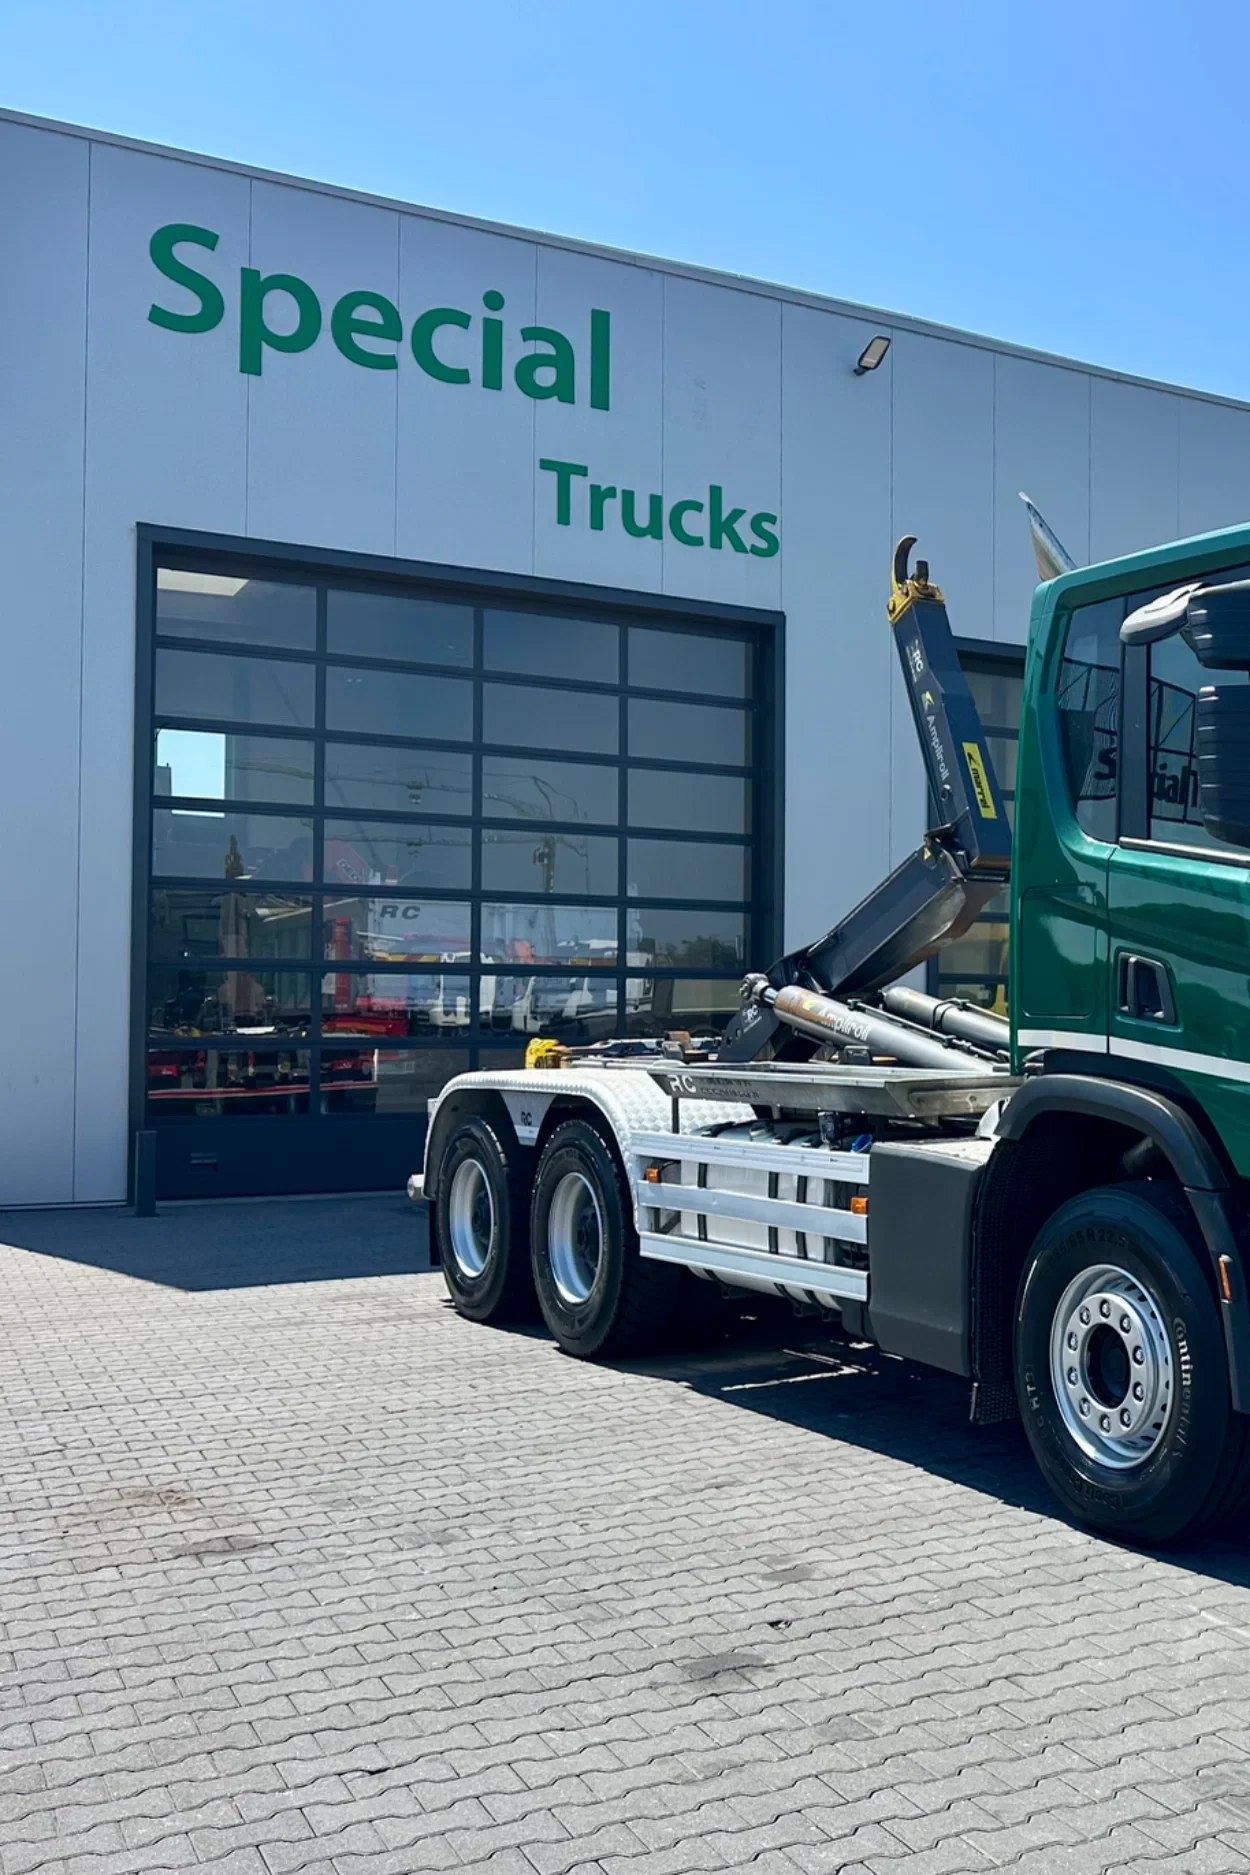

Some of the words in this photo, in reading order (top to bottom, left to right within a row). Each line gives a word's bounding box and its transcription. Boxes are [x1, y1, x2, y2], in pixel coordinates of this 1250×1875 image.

[147, 222, 610, 411] Special
[539, 458, 780, 558] Trucks
[926, 715, 950, 781] Ampliroll
[971, 768, 991, 809] marrel
[380, 904, 421, 920] RC
[667, 1074, 697, 1094] RC
[520, 1111, 533, 1127] RC
[1086, 1227, 1096, 1242] R
[1098, 1228, 1127, 1248] 22.5
